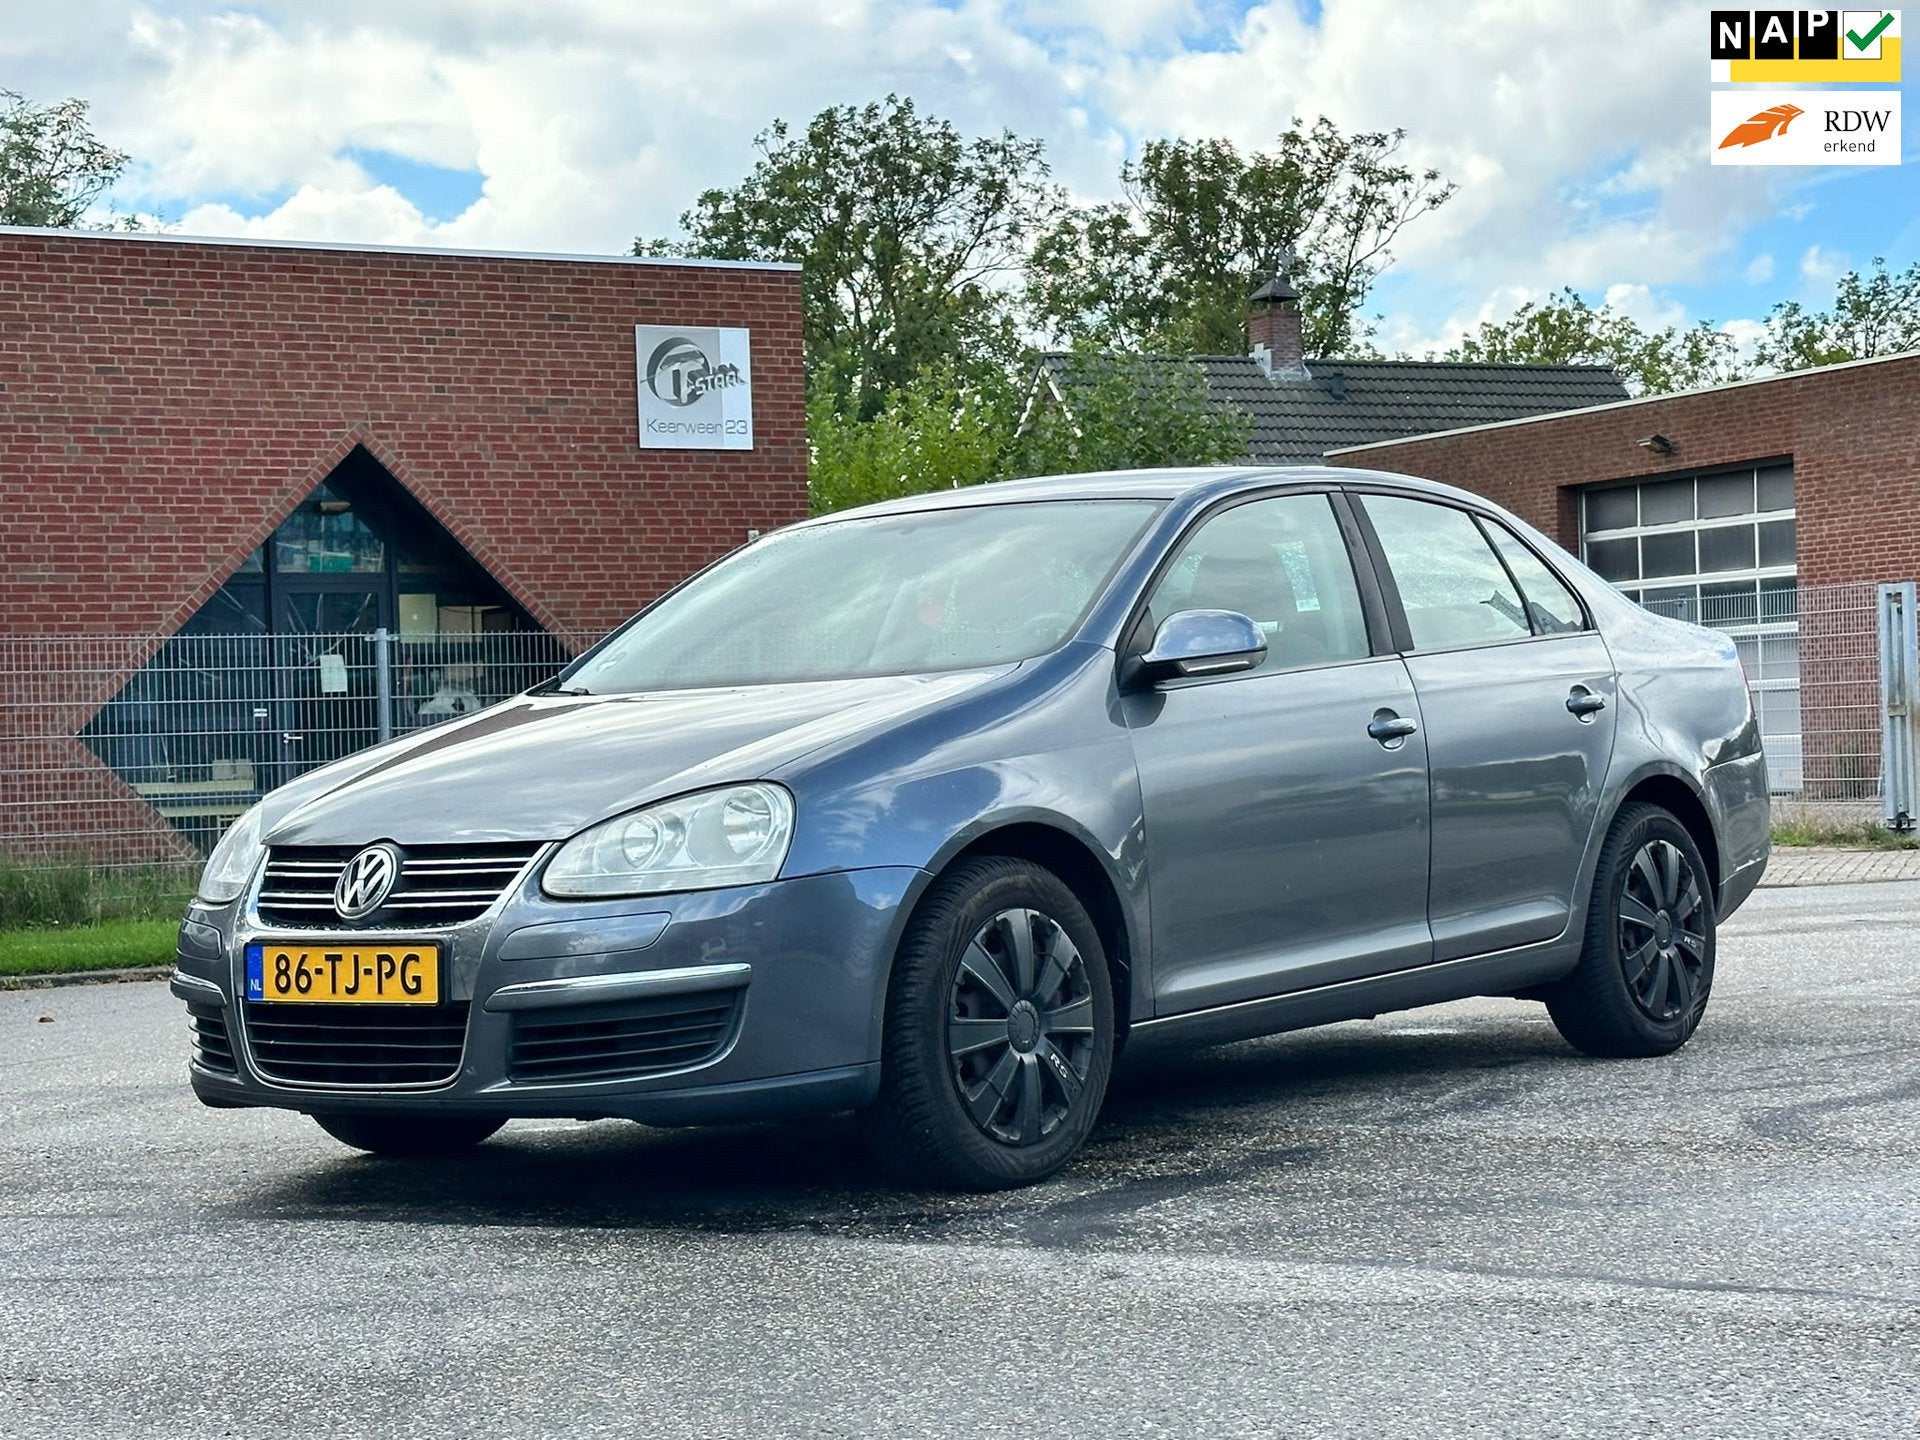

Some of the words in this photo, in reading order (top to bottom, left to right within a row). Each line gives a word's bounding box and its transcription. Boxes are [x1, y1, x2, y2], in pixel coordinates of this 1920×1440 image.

[725, 420, 748, 434] 23
[250, 979, 262, 991] NL
[274, 953, 422, 995] 86-TJ-PG
